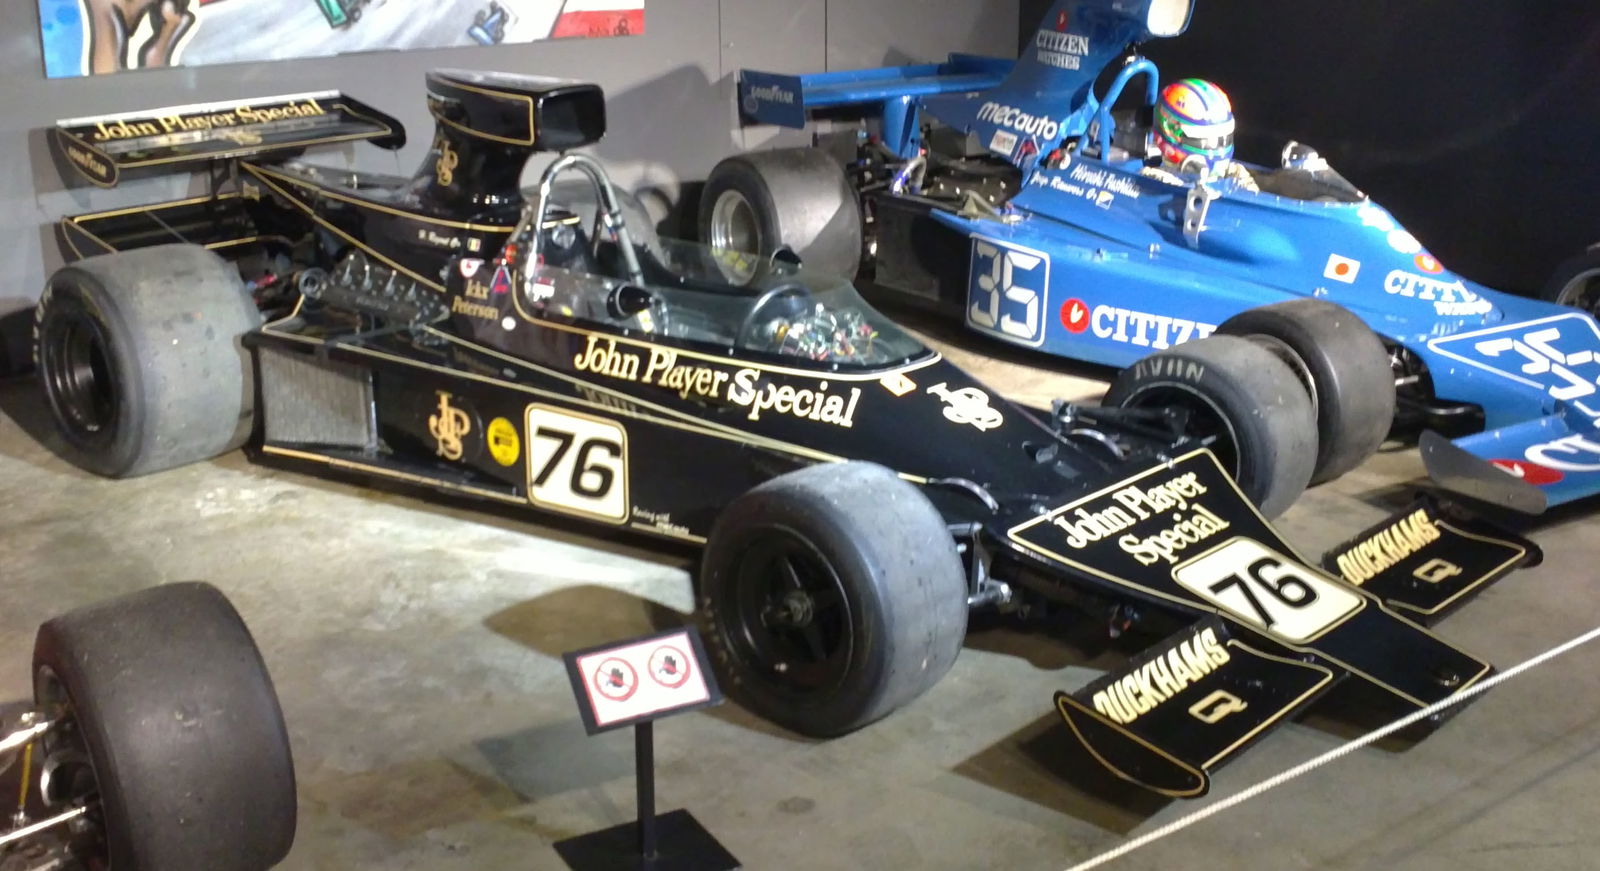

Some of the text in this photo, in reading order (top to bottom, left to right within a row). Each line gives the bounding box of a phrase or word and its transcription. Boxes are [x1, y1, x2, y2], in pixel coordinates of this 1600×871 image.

[1036, 29, 1089, 57] CITIZEN
[94, 98, 326, 142] John Player Special
[976, 101, 1058, 141] mecauto
[970, 238, 1039, 339] 35
[574, 335, 640, 380] John
[641, 347, 728, 399] Player
[727, 368, 861, 427] Special
[533, 425, 623, 500] 76
[1053, 471, 1207, 549] John Player
[1118, 503, 1230, 567] Special
[1336, 508, 1441, 586] DUCKHAMS
[1208, 557, 1320, 630] 76
[1092, 627, 1231, 725] DUCKHAMS
